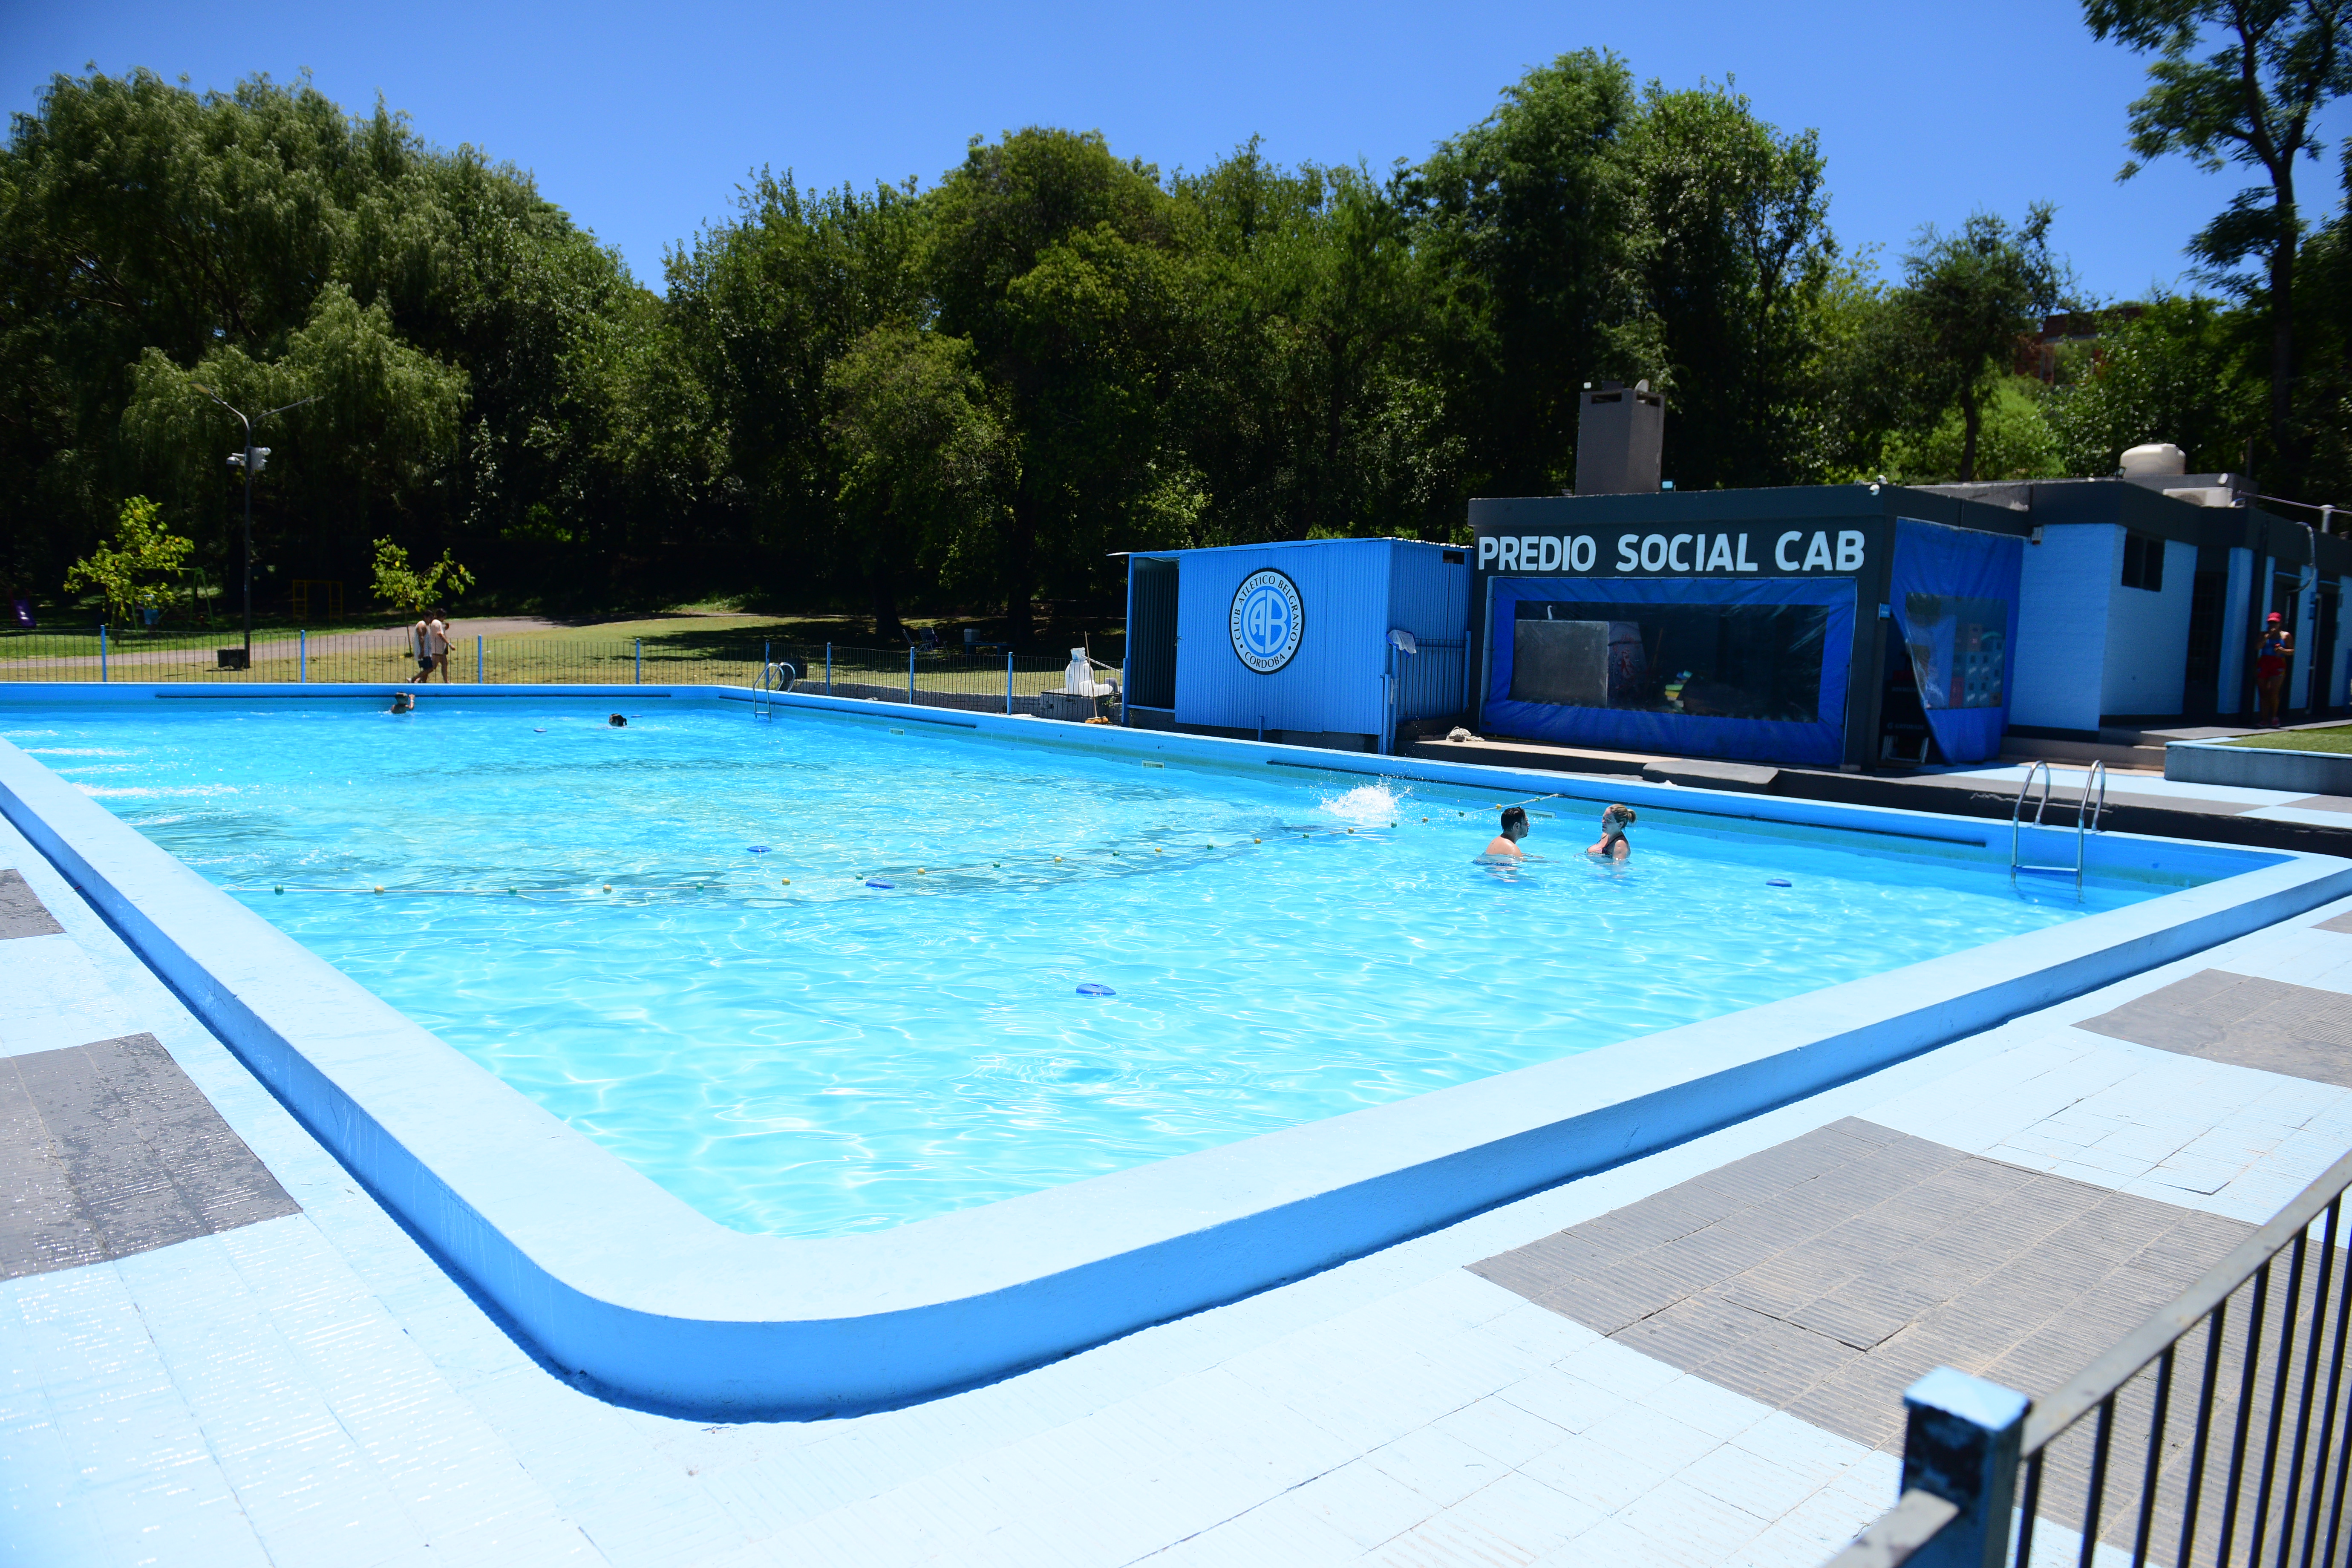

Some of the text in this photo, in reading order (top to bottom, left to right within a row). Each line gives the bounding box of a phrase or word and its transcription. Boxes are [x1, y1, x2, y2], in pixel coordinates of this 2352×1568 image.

[1478, 530, 1865, 572] PREDIO SOCIAL CAB
[1233, 574, 1299, 642] CLUB ATLETICO BELGRANO
[1244, 651, 1286, 668] CORDOBA
